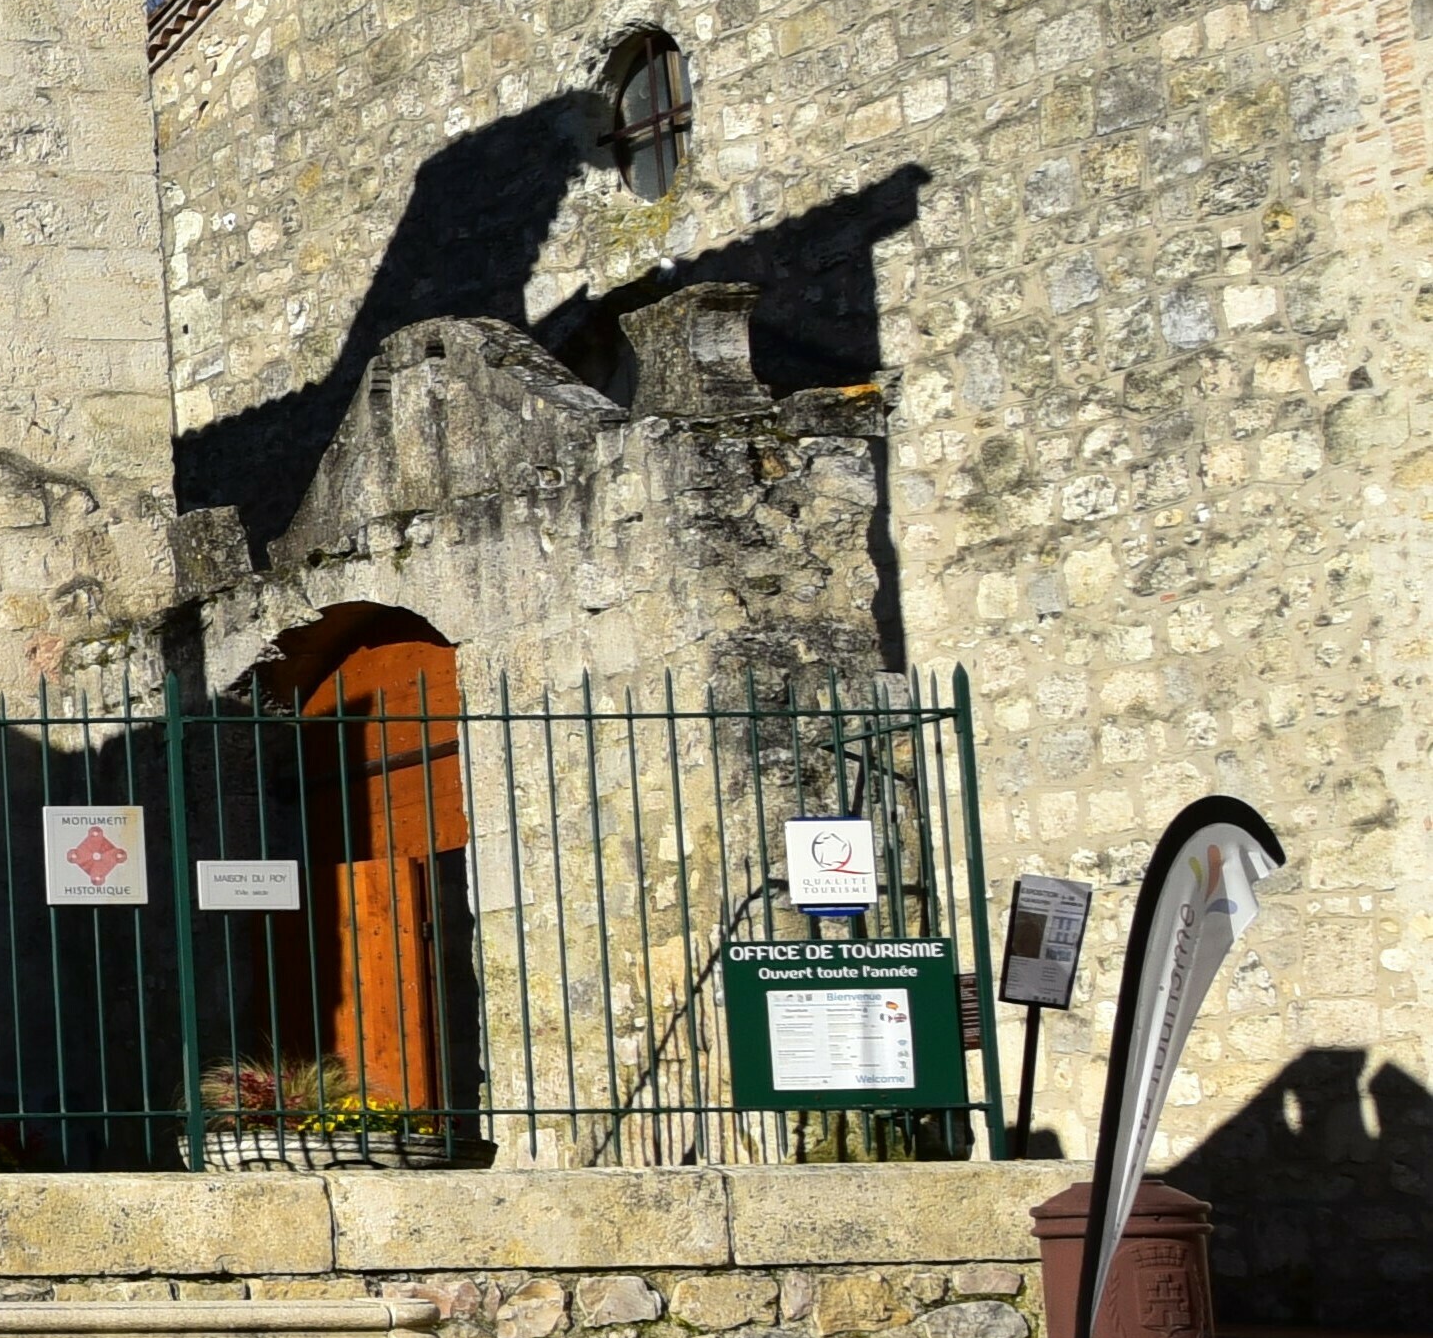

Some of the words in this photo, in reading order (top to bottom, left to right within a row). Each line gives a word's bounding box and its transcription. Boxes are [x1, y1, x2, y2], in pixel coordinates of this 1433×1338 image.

[61, 816, 128, 826] MONUMENT
[213, 874, 248, 883] MAISON
[251, 874, 265, 883] DU
[269, 874, 287, 883] ROY
[64, 886, 132, 896] HISTORIQUE
[729, 945, 801, 961] OFFICE
[805, 944, 834, 960] DE
[838, 942, 945, 959] TOURISME
[758, 966, 814, 980] Ouvert
[817, 965, 859, 979] toute
[862, 964, 918, 978] l'année
[826, 992, 882, 1002] Bienvenue
[855, 1074, 906, 1084] Welcome
